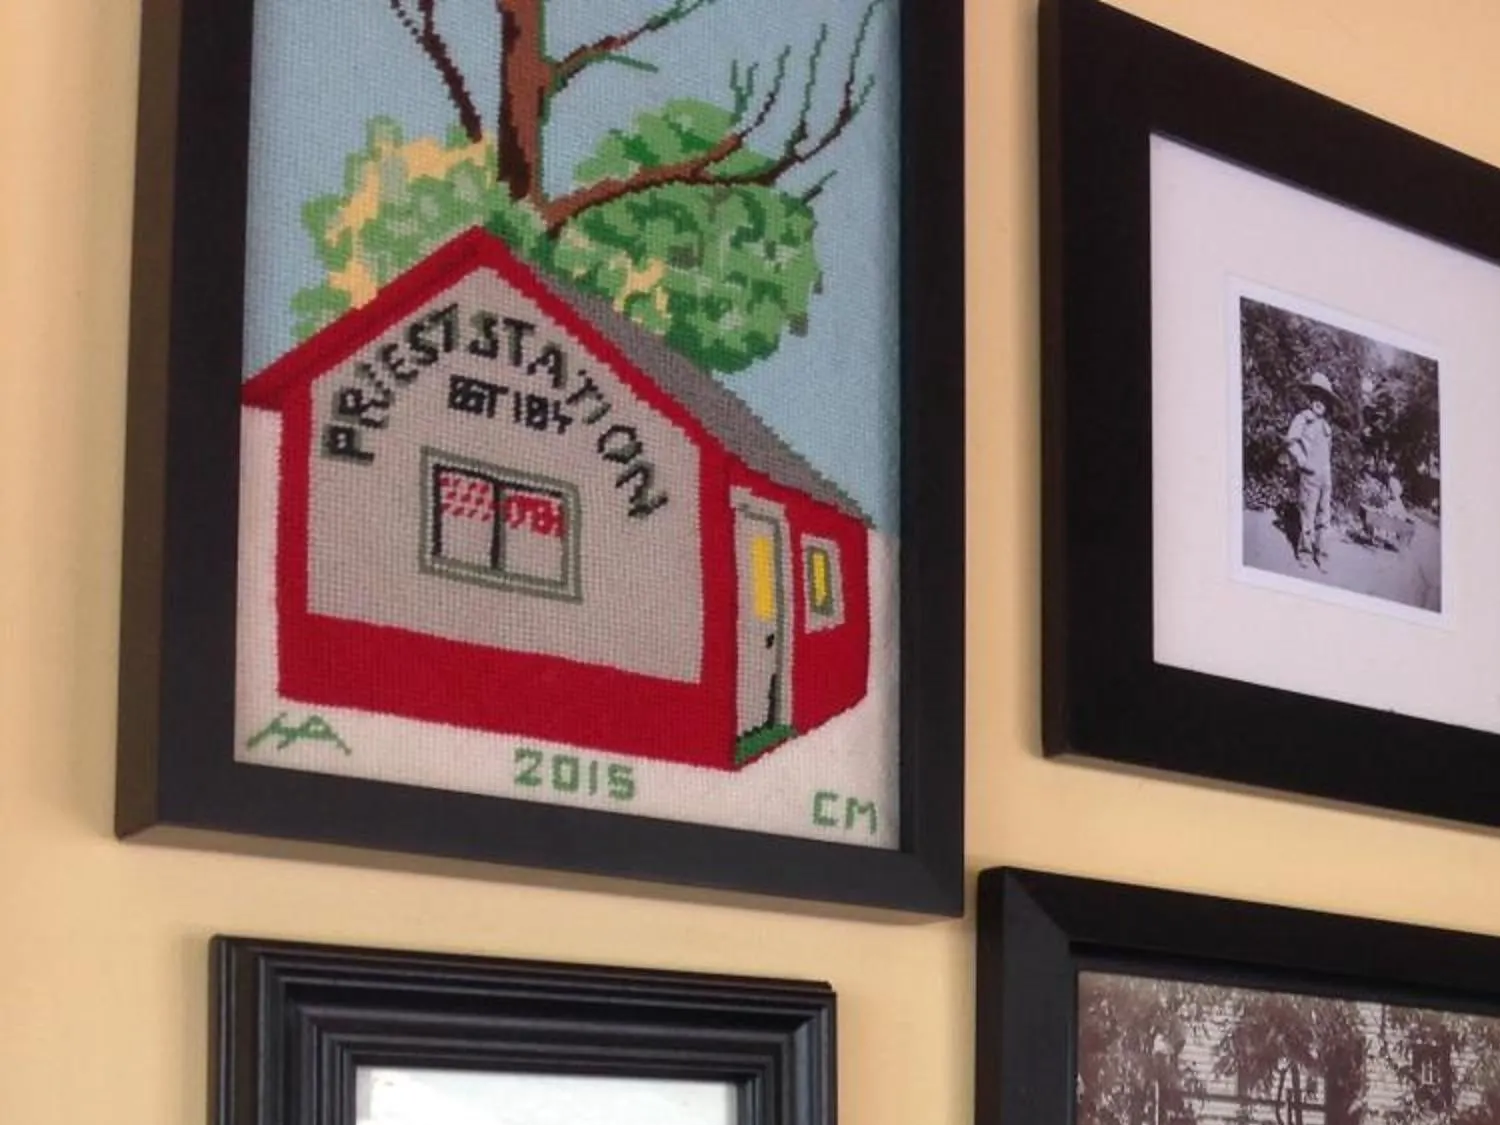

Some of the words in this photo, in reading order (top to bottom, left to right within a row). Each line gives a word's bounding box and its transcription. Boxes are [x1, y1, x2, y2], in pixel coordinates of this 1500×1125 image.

[468, 310, 669, 519] STATION
[513, 746, 638, 801] 2015
[812, 790, 878, 835] CM
